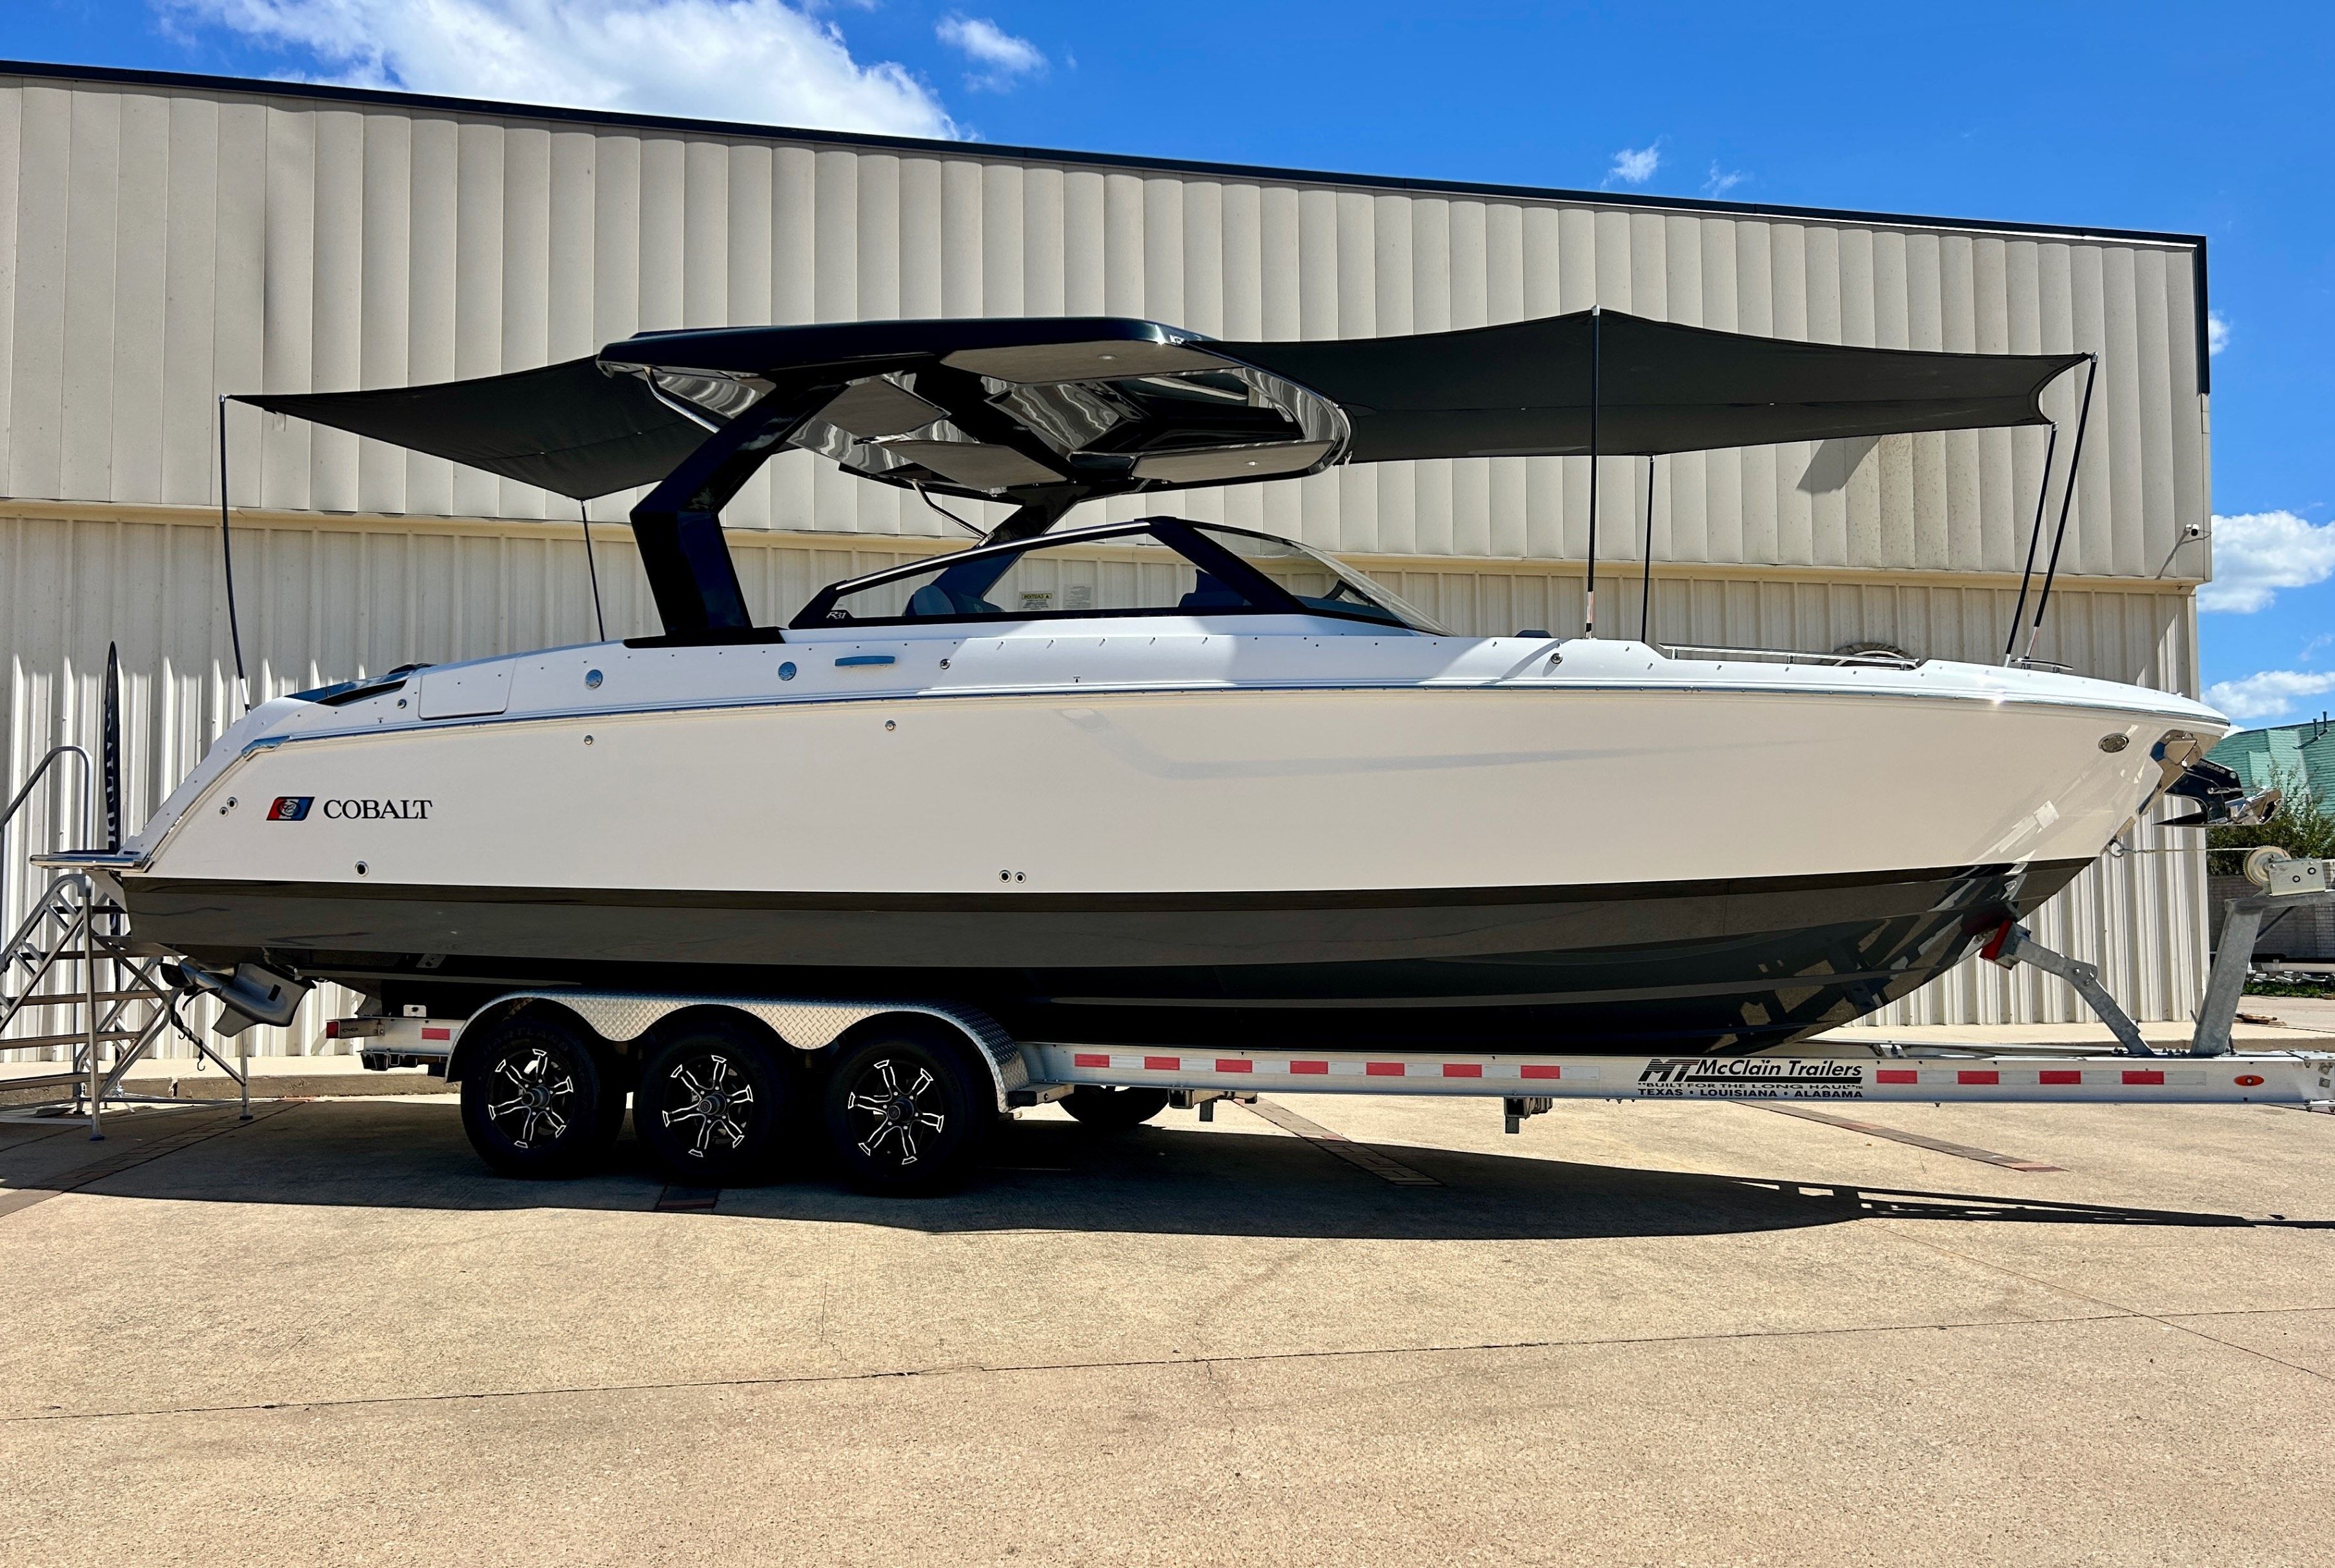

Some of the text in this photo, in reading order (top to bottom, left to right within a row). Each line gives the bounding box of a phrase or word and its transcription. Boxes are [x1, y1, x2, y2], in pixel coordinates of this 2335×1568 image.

[826, 611, 847, 619] R31
[323, 799, 433, 819] COBALT
[1695, 1059, 1863, 1076] McClain Trailers
